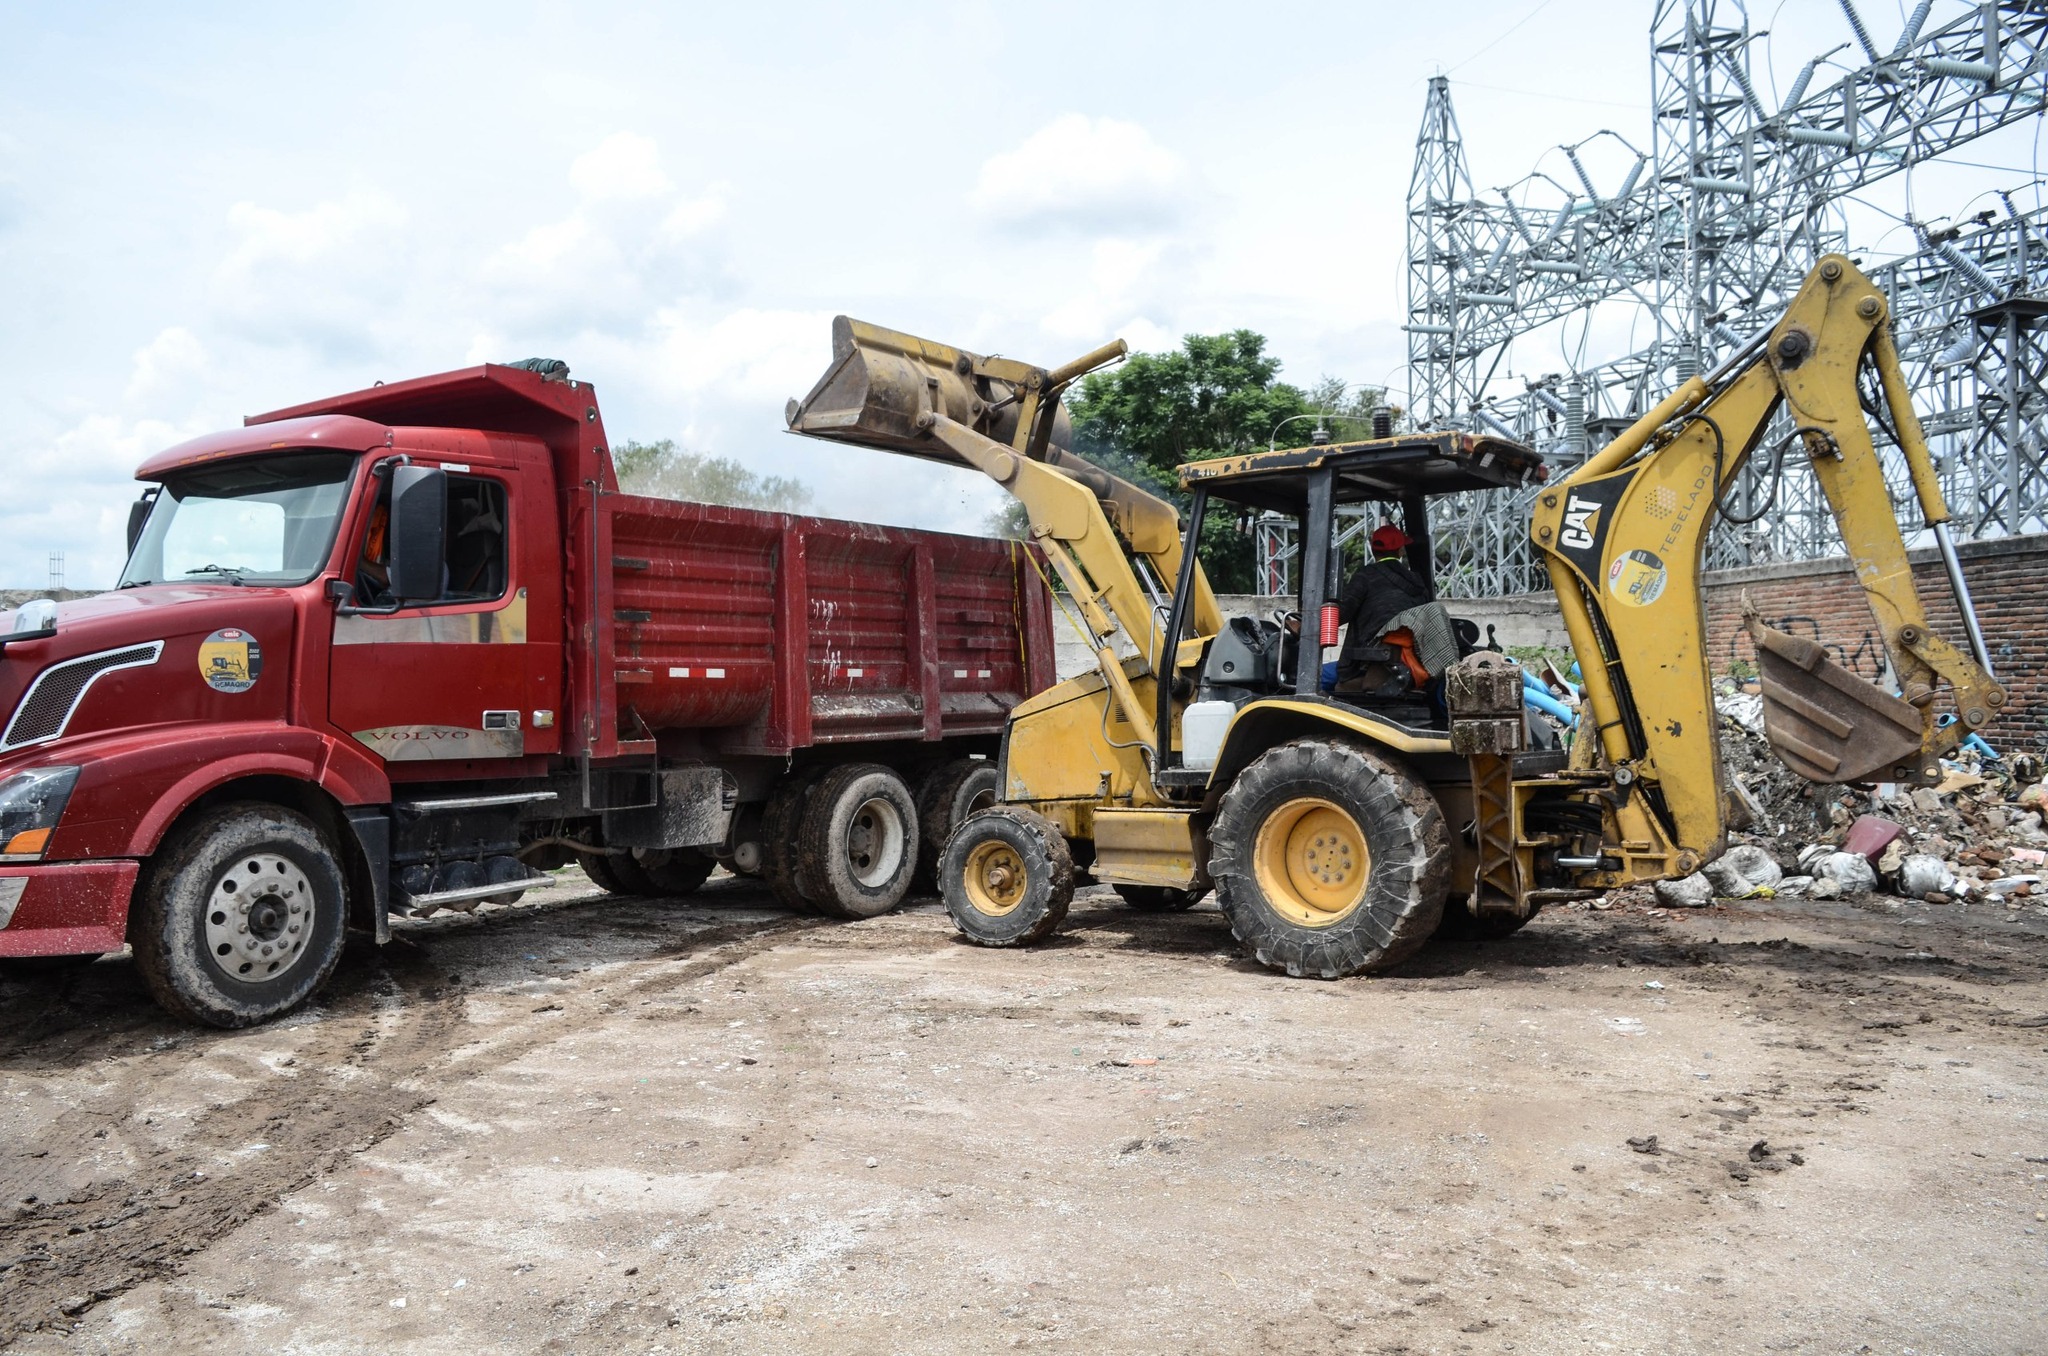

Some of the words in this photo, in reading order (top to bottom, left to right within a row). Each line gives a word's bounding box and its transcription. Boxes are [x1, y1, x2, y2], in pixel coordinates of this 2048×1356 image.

[1560, 495, 1602, 550] CAT
[1660, 464, 1713, 553] TESELADO
[370, 731, 470, 741] VOLVO
